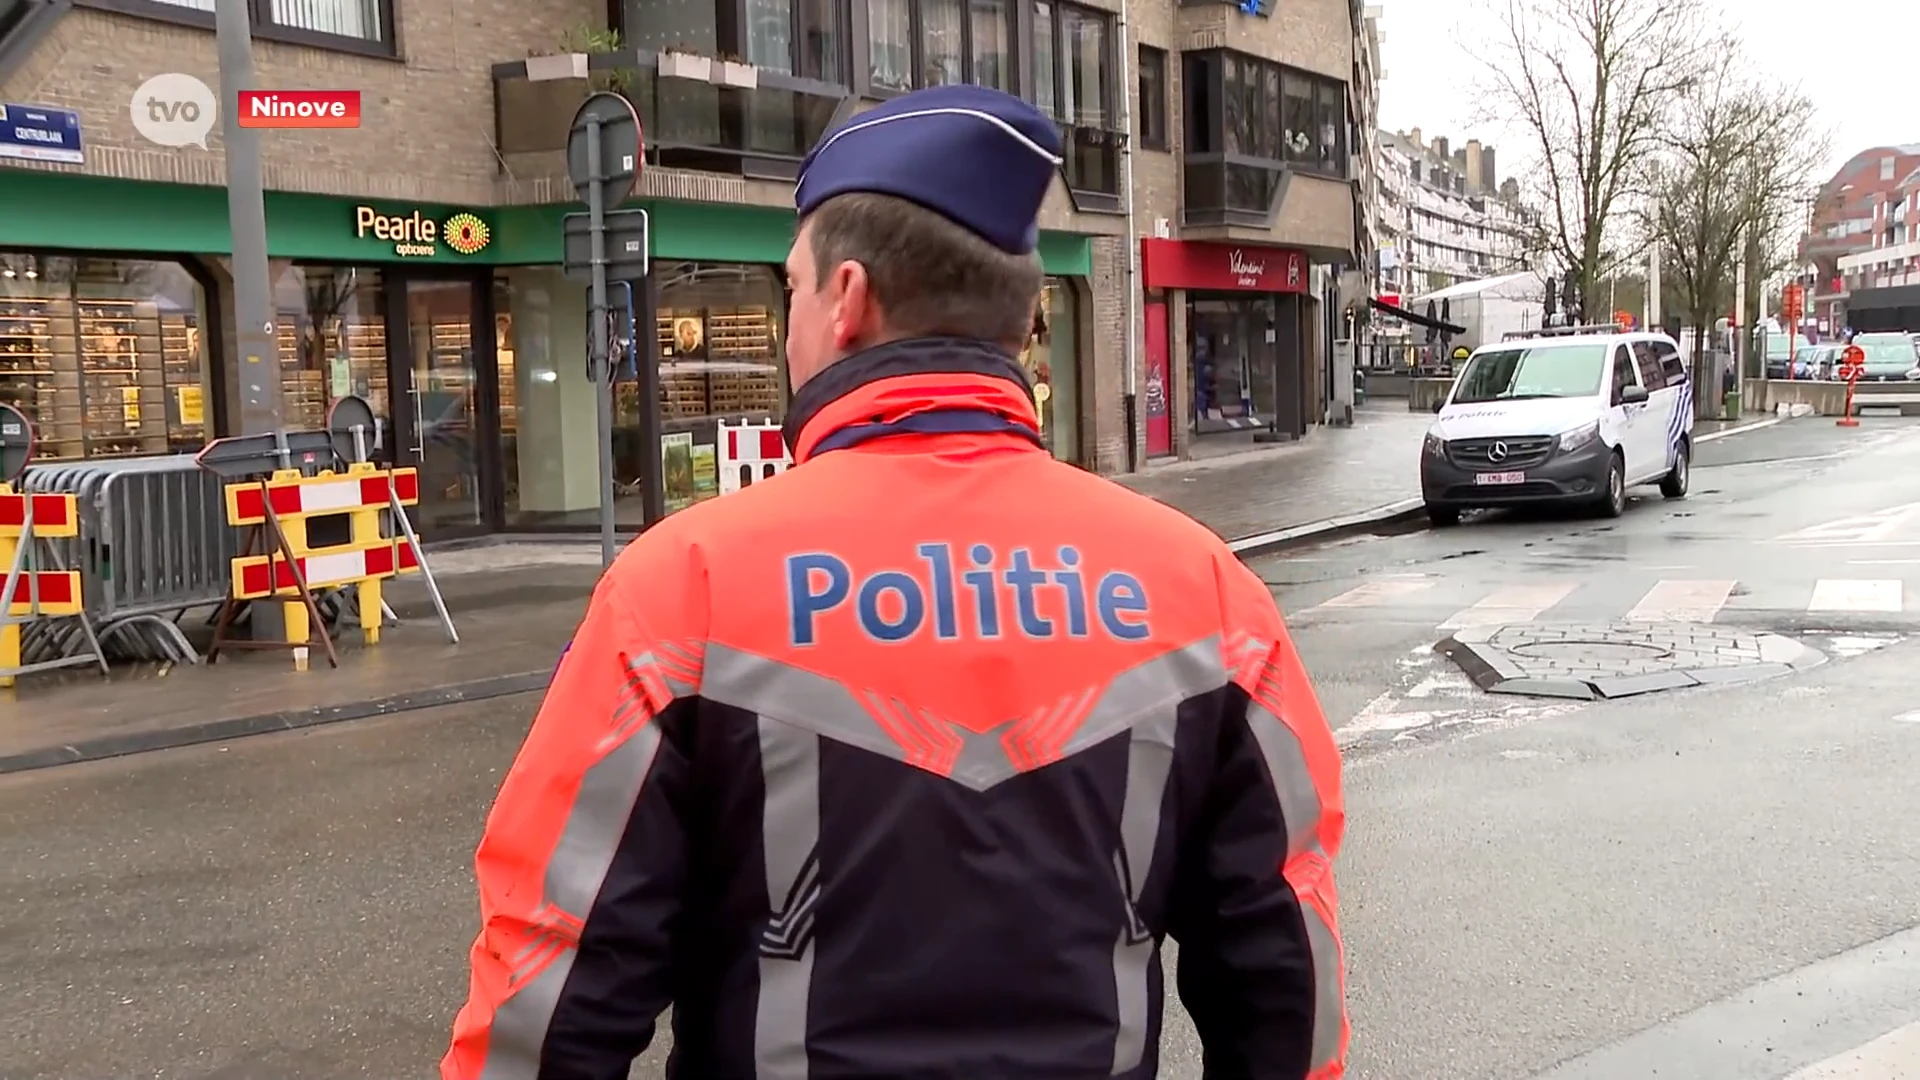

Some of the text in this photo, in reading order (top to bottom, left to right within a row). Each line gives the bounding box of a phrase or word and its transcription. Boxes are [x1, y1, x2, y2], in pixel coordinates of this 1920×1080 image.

[357, 206, 436, 242] Pearle
[396, 243, 435, 257] opticiens
[786, 542, 1151, 646] Politie
